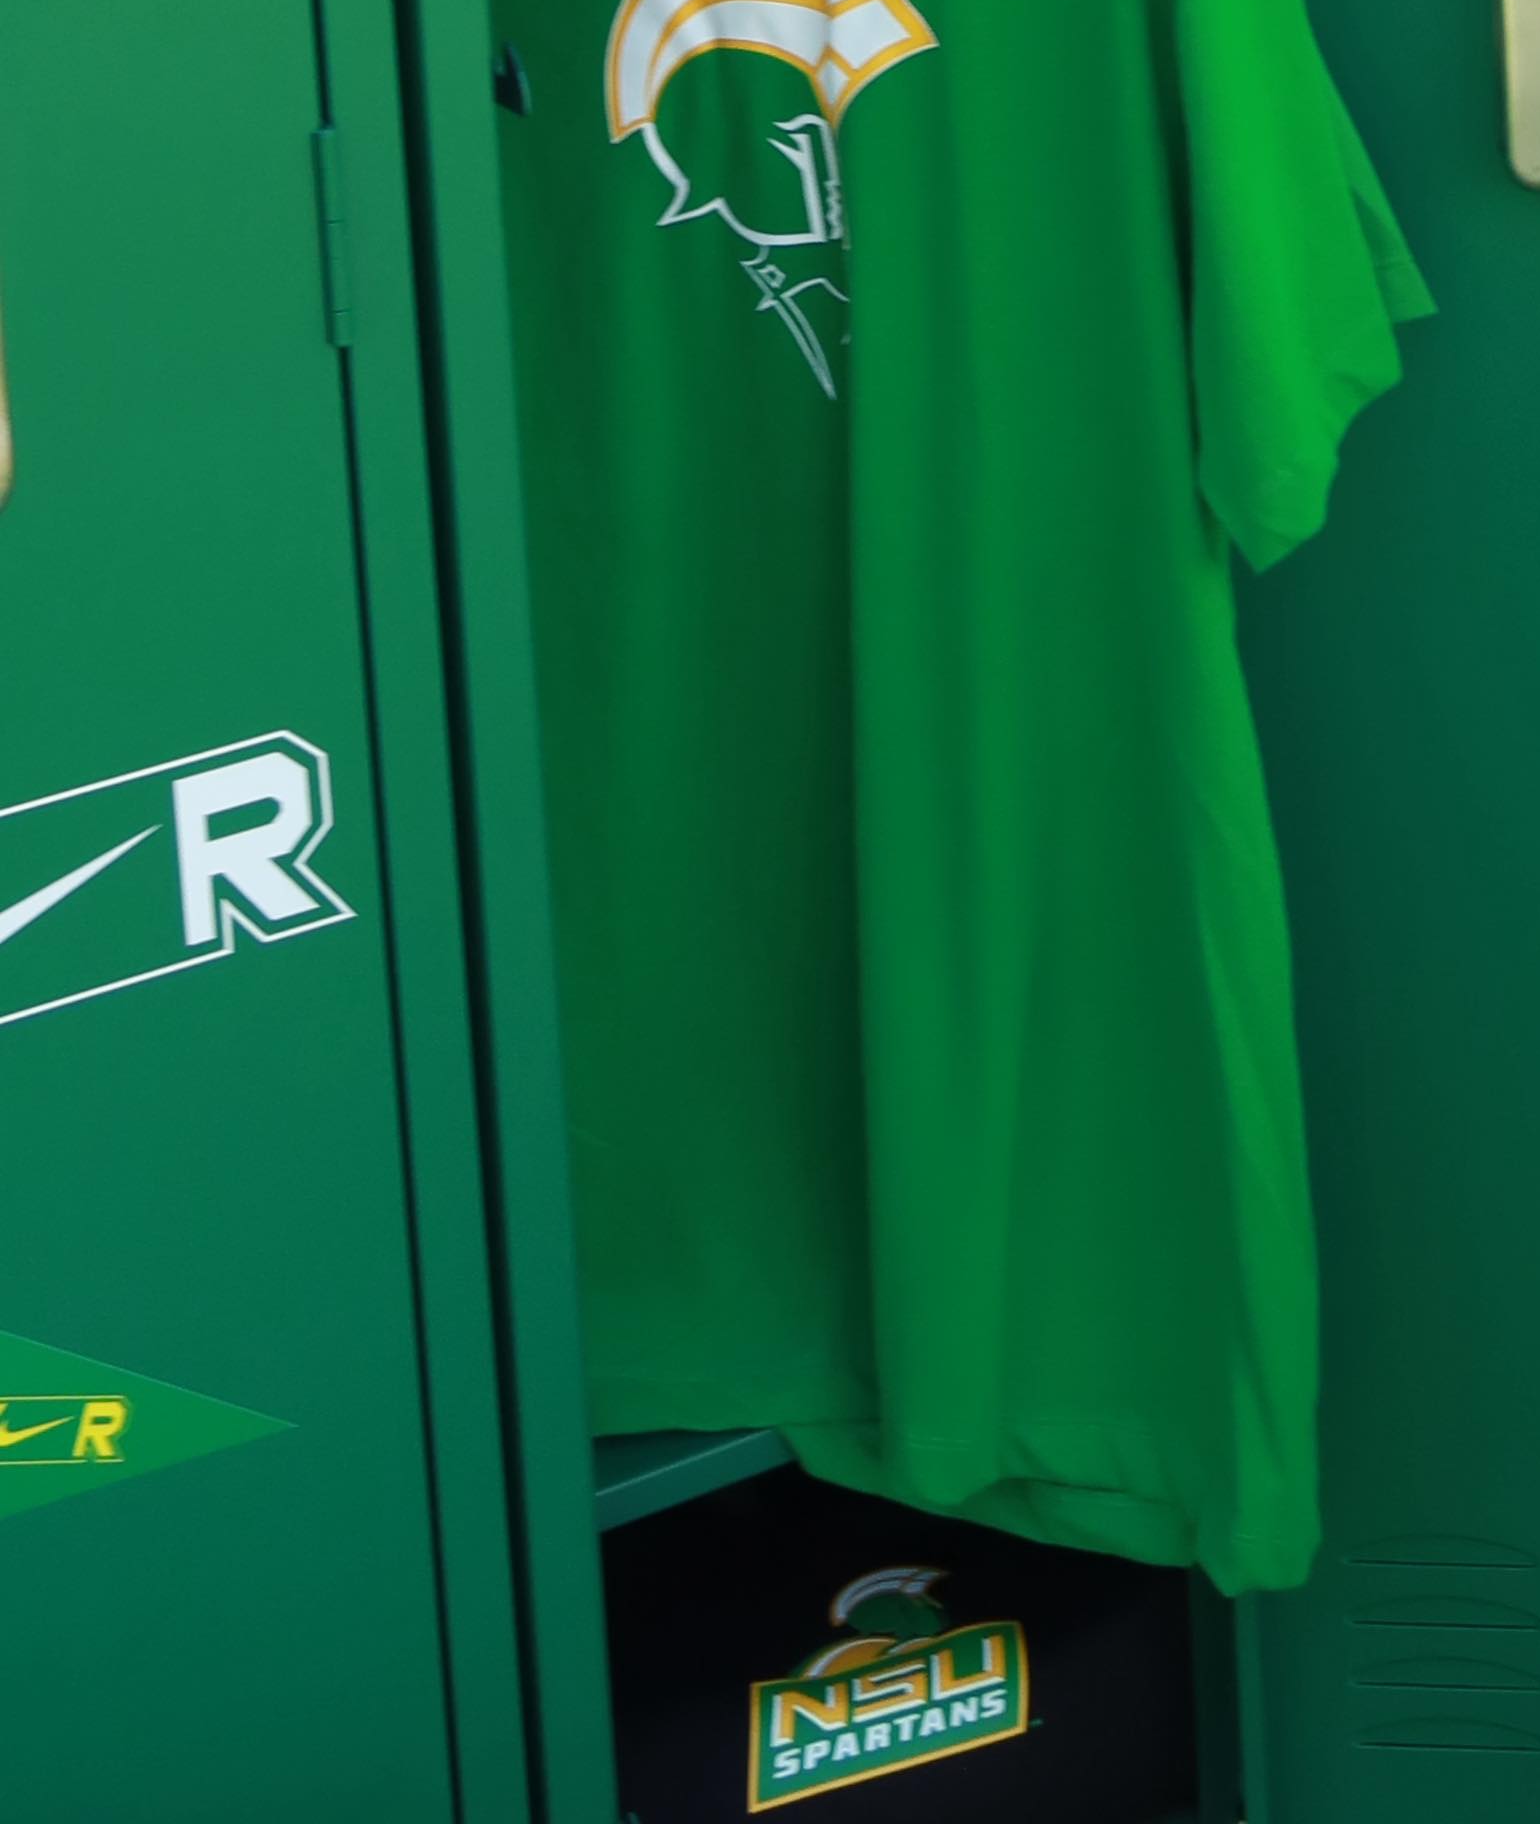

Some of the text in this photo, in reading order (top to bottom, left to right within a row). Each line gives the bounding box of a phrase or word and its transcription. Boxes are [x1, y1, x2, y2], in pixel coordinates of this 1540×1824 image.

[172, 751, 321, 946] R
[770, 1635, 1007, 1748] NSU
[772, 1688, 1008, 1779] SPARTANS
